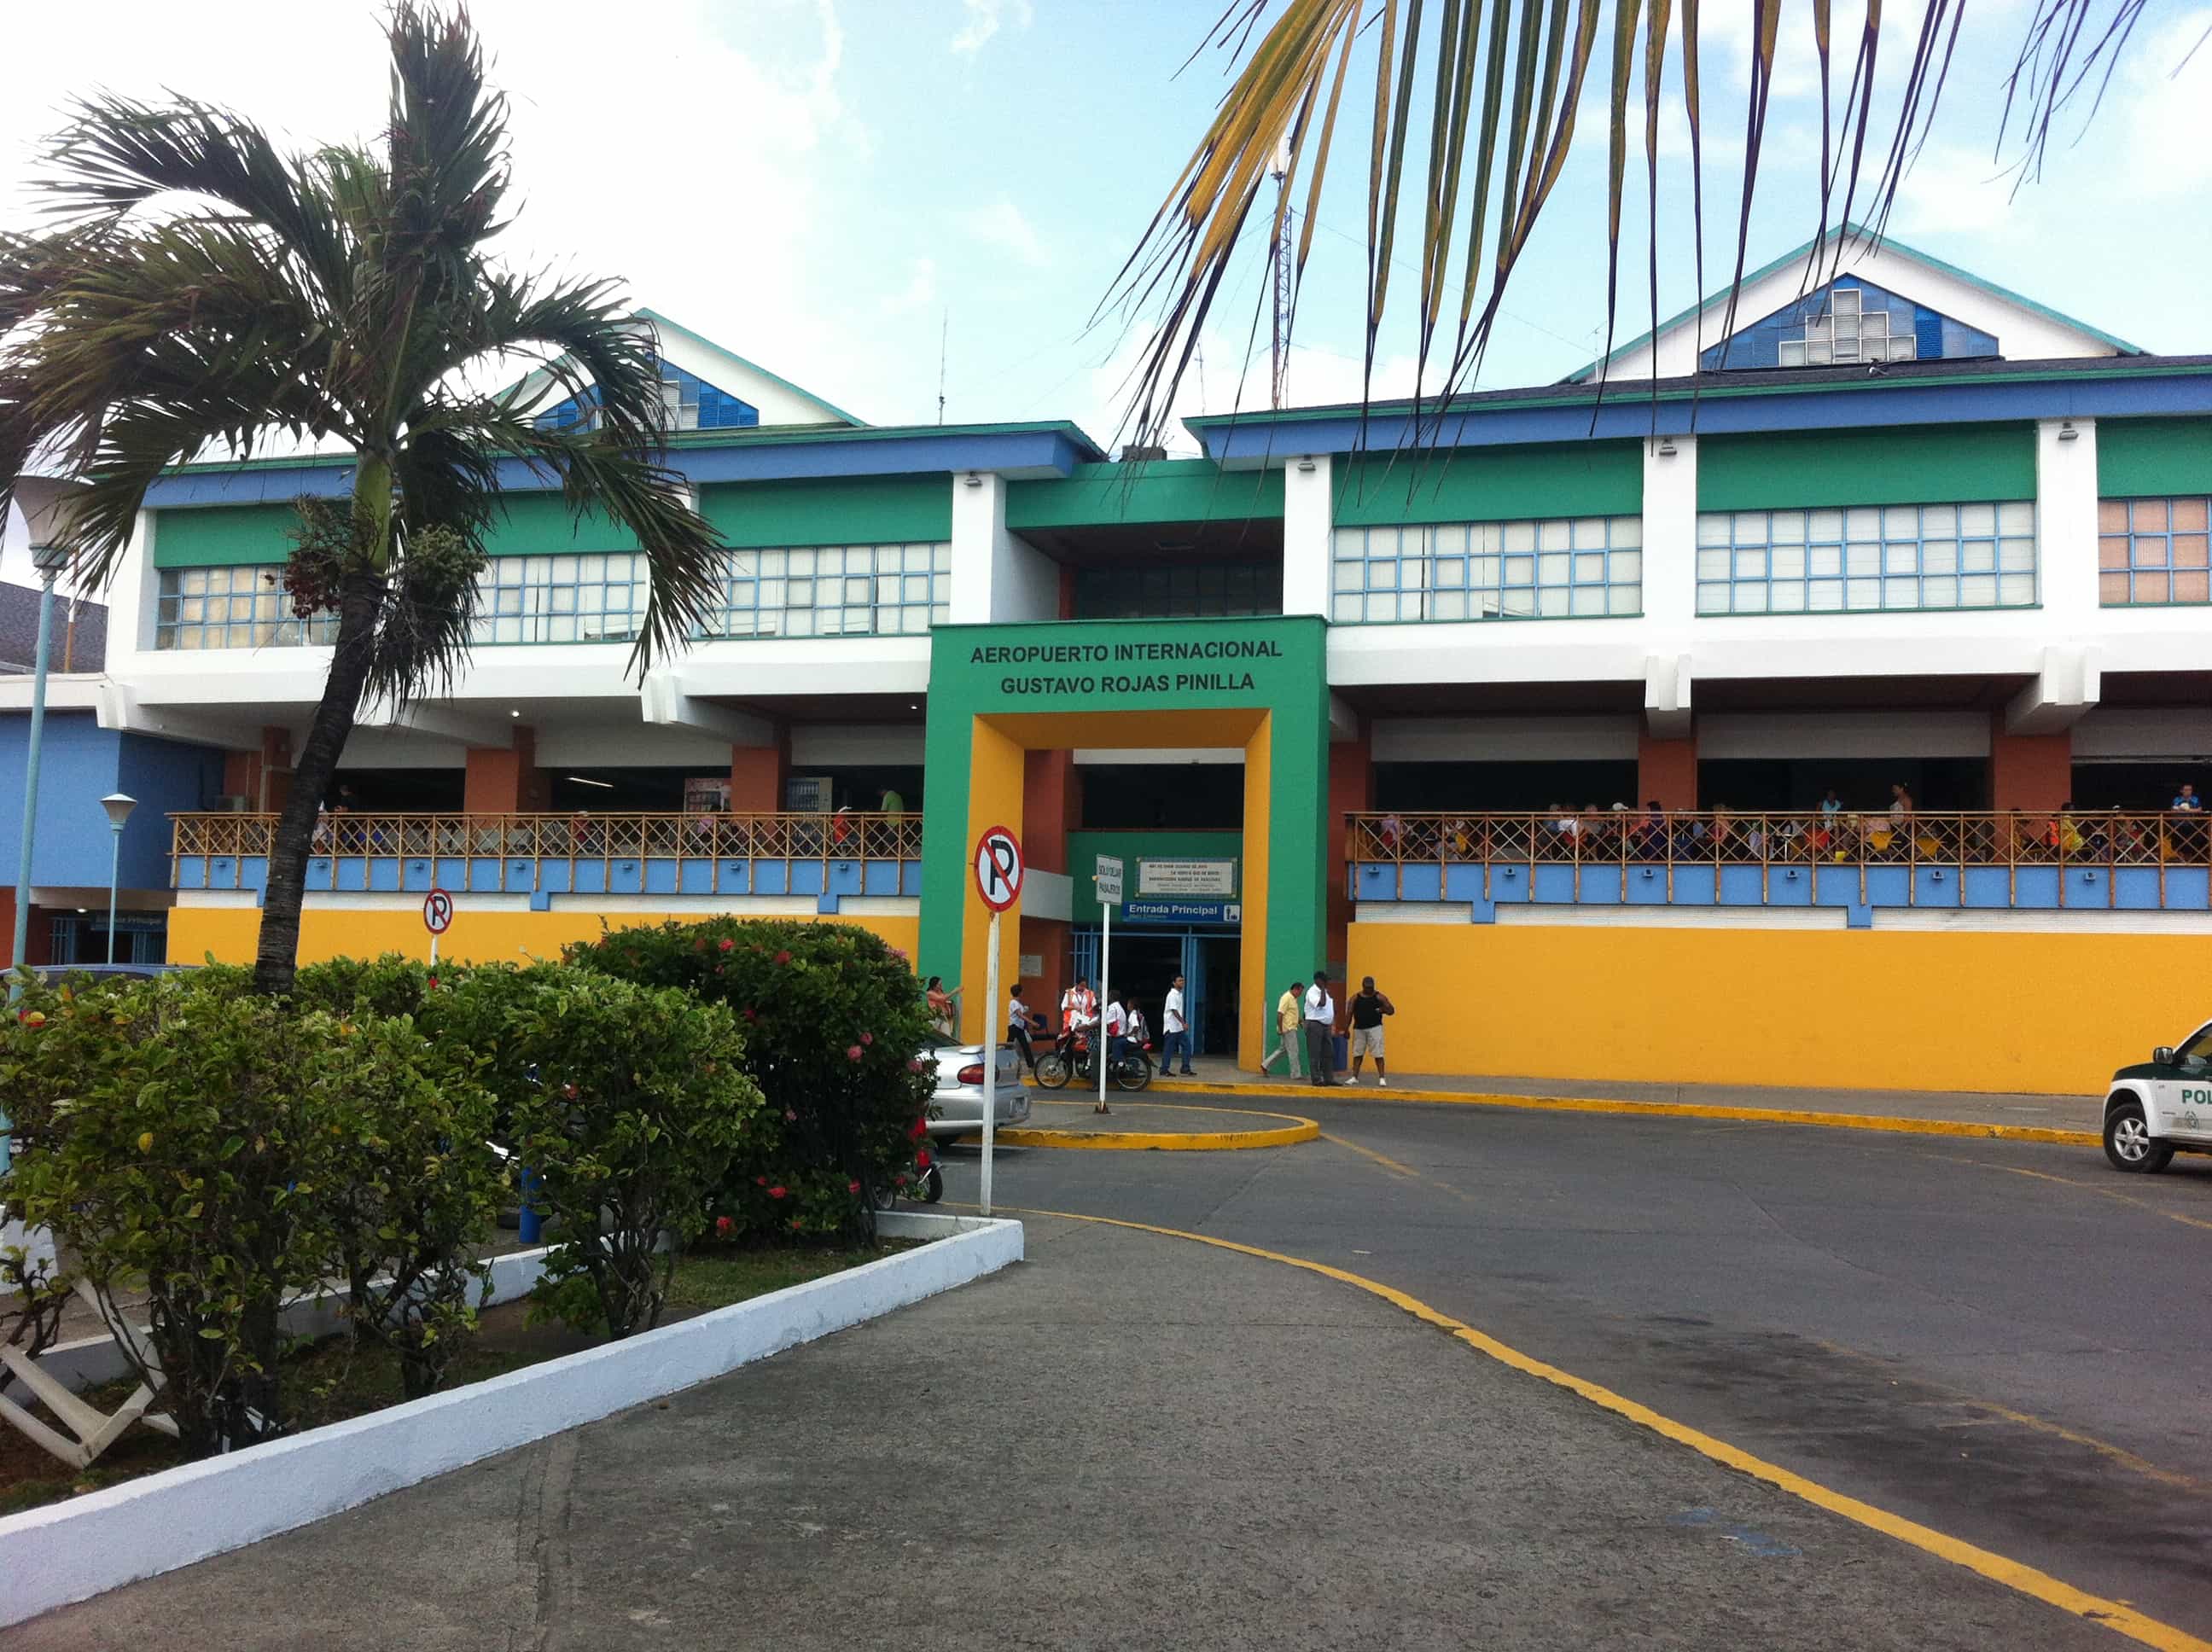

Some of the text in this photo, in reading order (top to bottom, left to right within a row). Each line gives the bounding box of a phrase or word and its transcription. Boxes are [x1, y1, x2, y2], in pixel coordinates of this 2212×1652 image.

[970, 641, 1283, 663] AEROPUERTO INTERNACIONAL
[1001, 672, 1255, 695] GUSTAVO ROJAS PINILLA
[1129, 905, 1169, 914] Entrada
[1172, 905, 1218, 916] Principal
